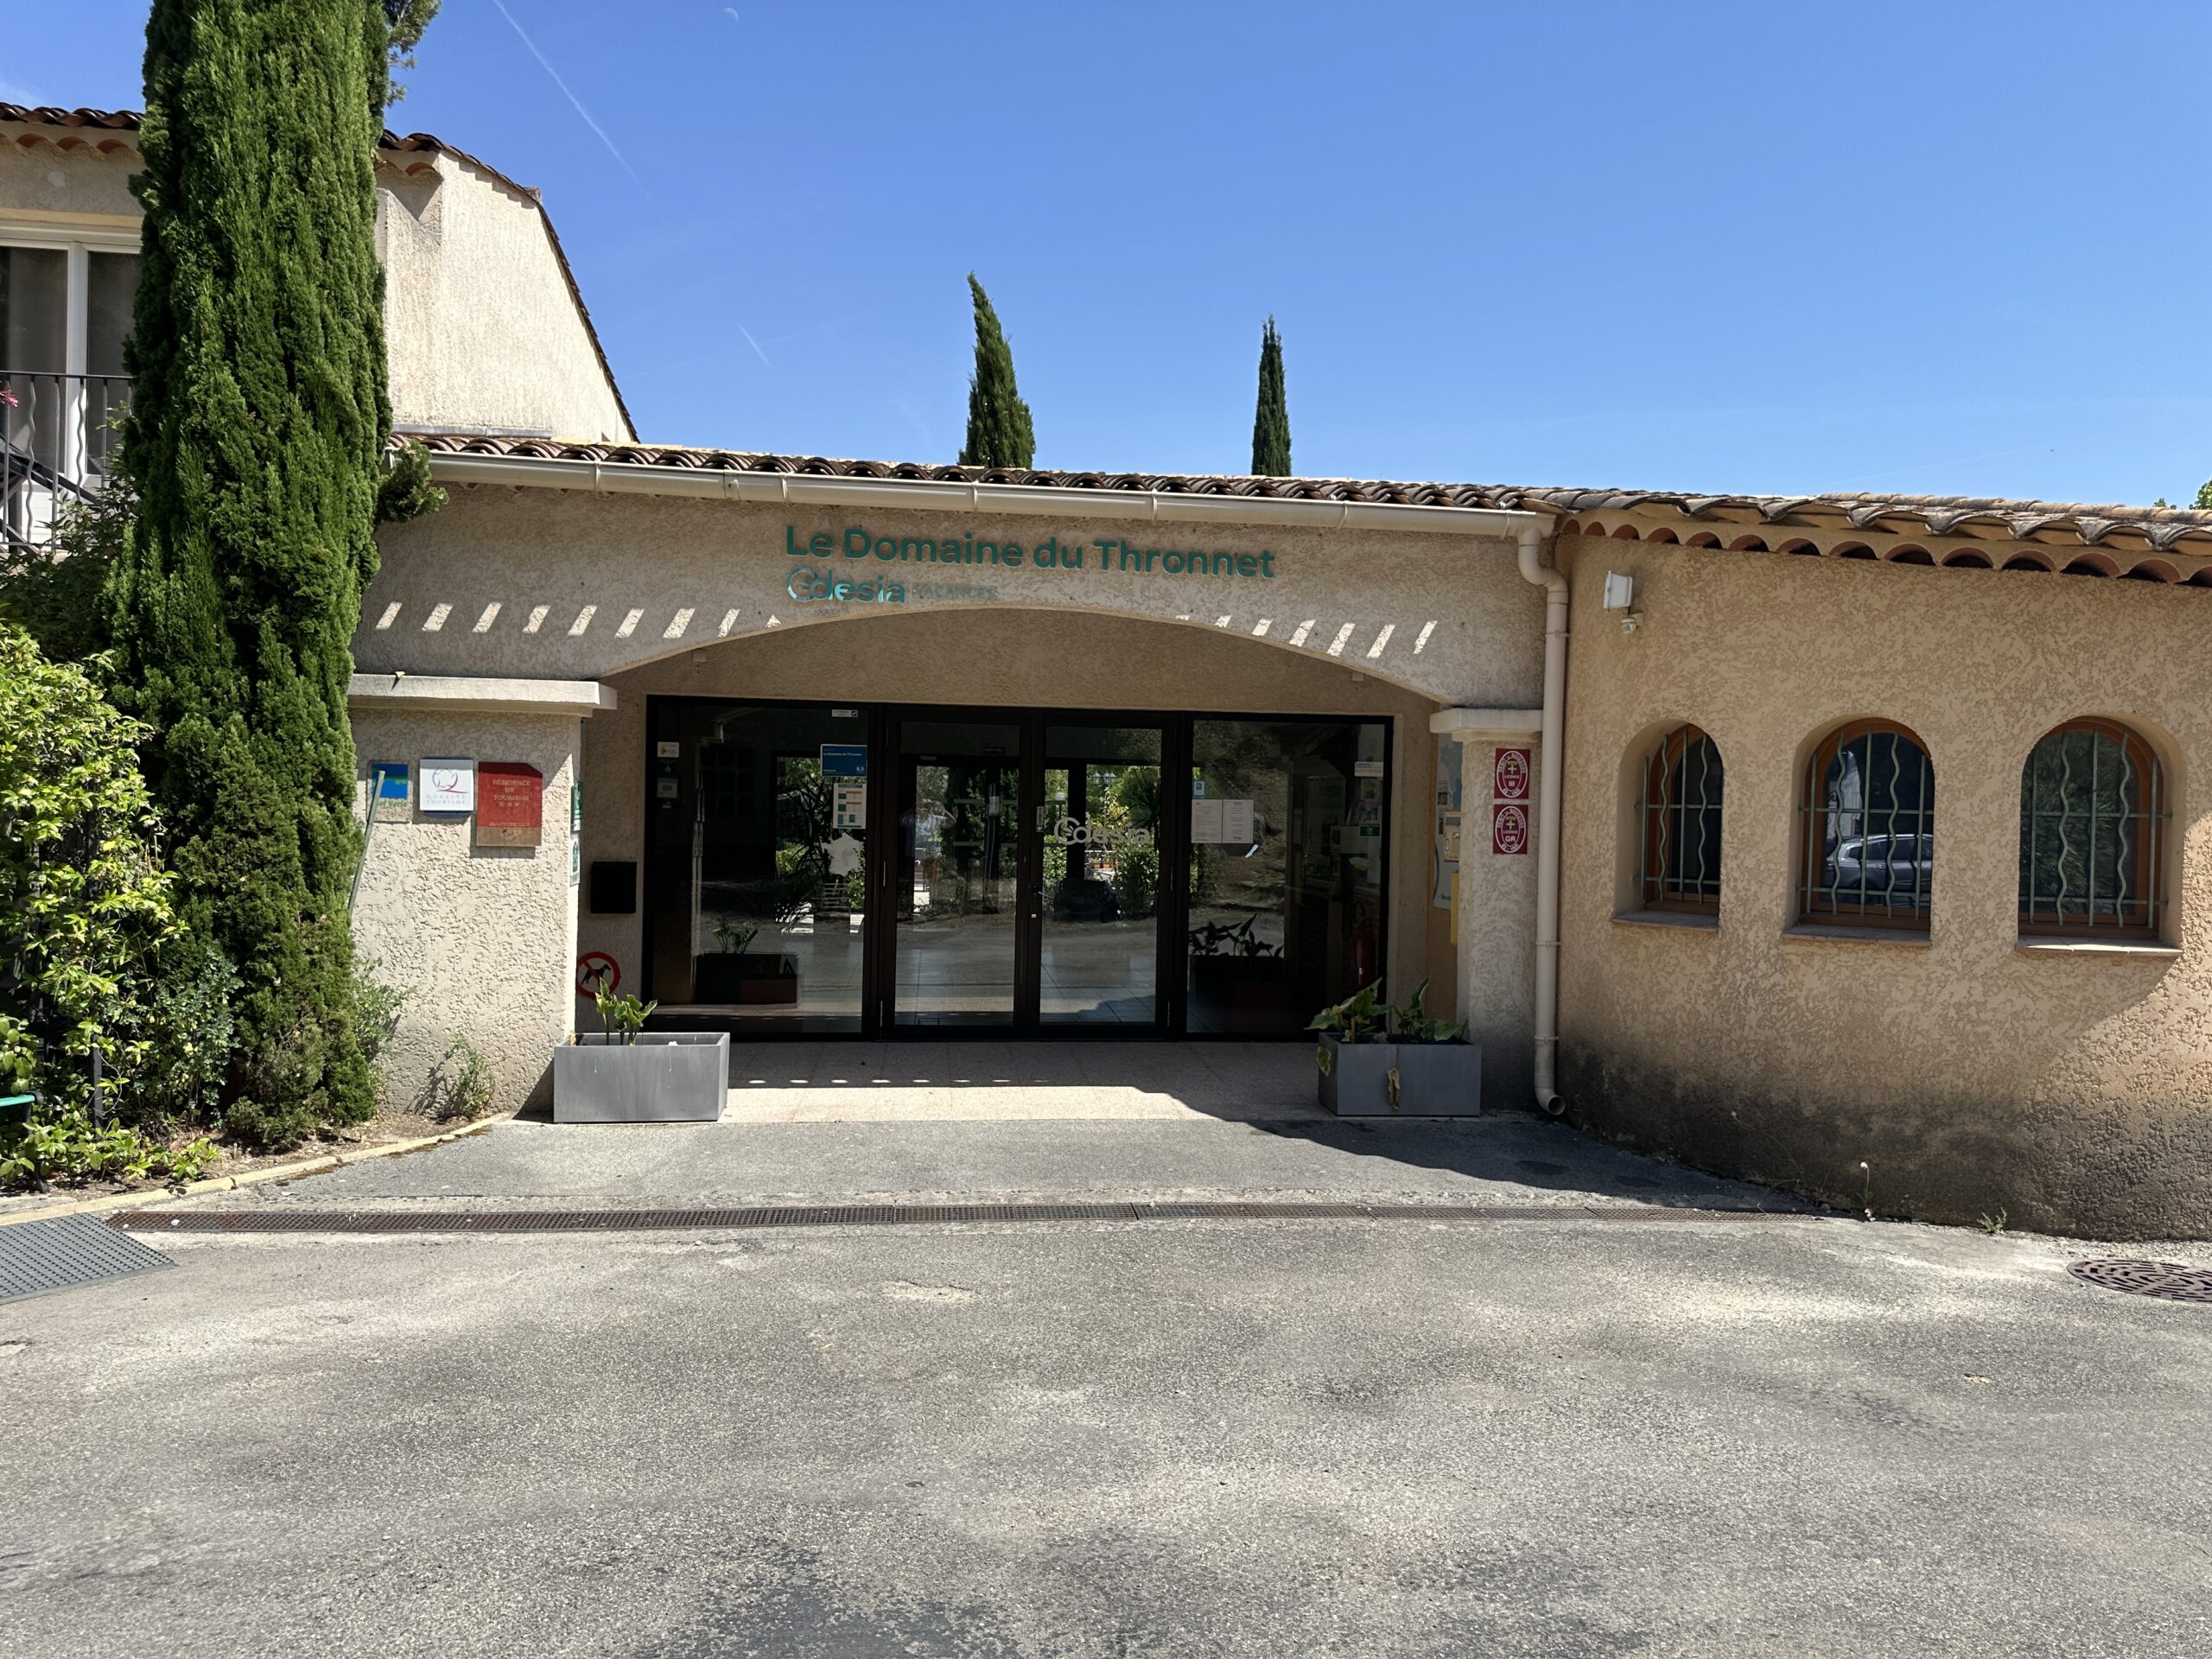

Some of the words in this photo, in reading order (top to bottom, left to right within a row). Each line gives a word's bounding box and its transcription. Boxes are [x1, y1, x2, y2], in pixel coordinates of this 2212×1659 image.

[786, 525, 834, 558] Le
[844, 528, 1024, 568] Domaine
[1033, 537, 1084, 570] du
[1092, 539, 1275, 579] Thronnet
